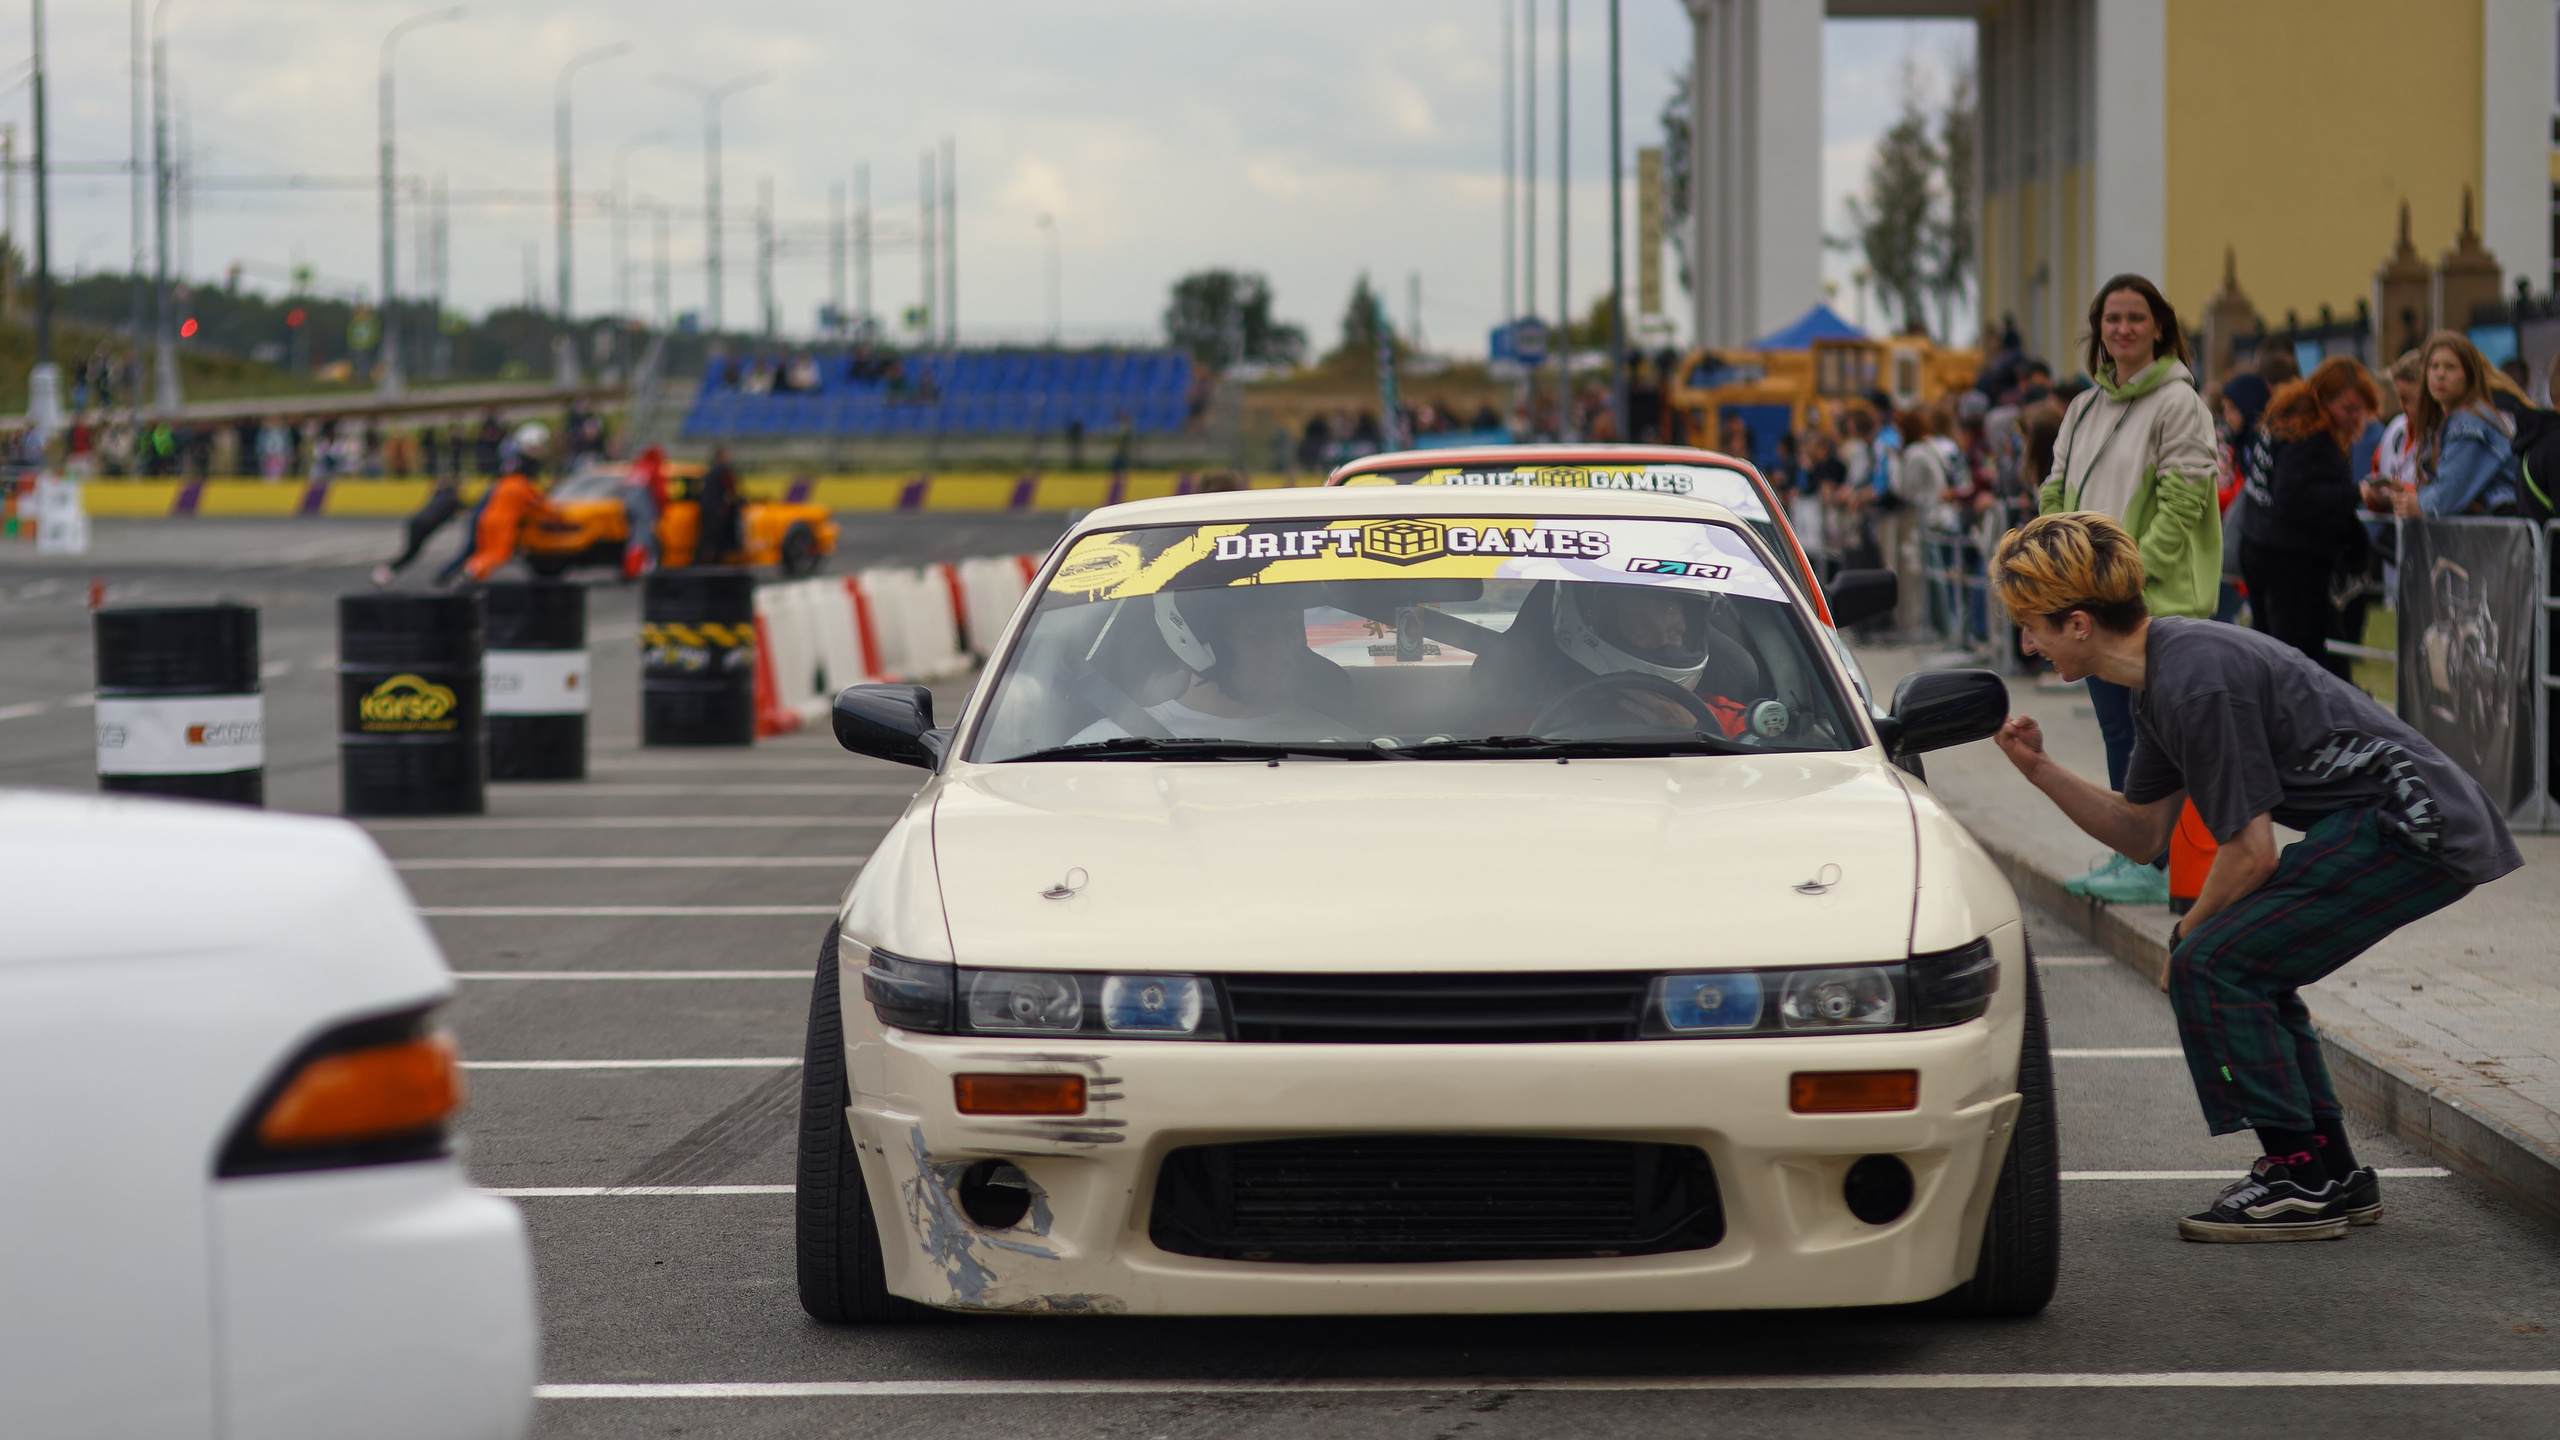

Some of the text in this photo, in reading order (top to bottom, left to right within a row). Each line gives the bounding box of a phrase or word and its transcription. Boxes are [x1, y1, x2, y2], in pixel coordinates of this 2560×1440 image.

[1589, 471, 1694, 492] GAMES
[1215, 527, 1610, 561] DRIFT GAMES
[1627, 559, 1730, 579] PARI
